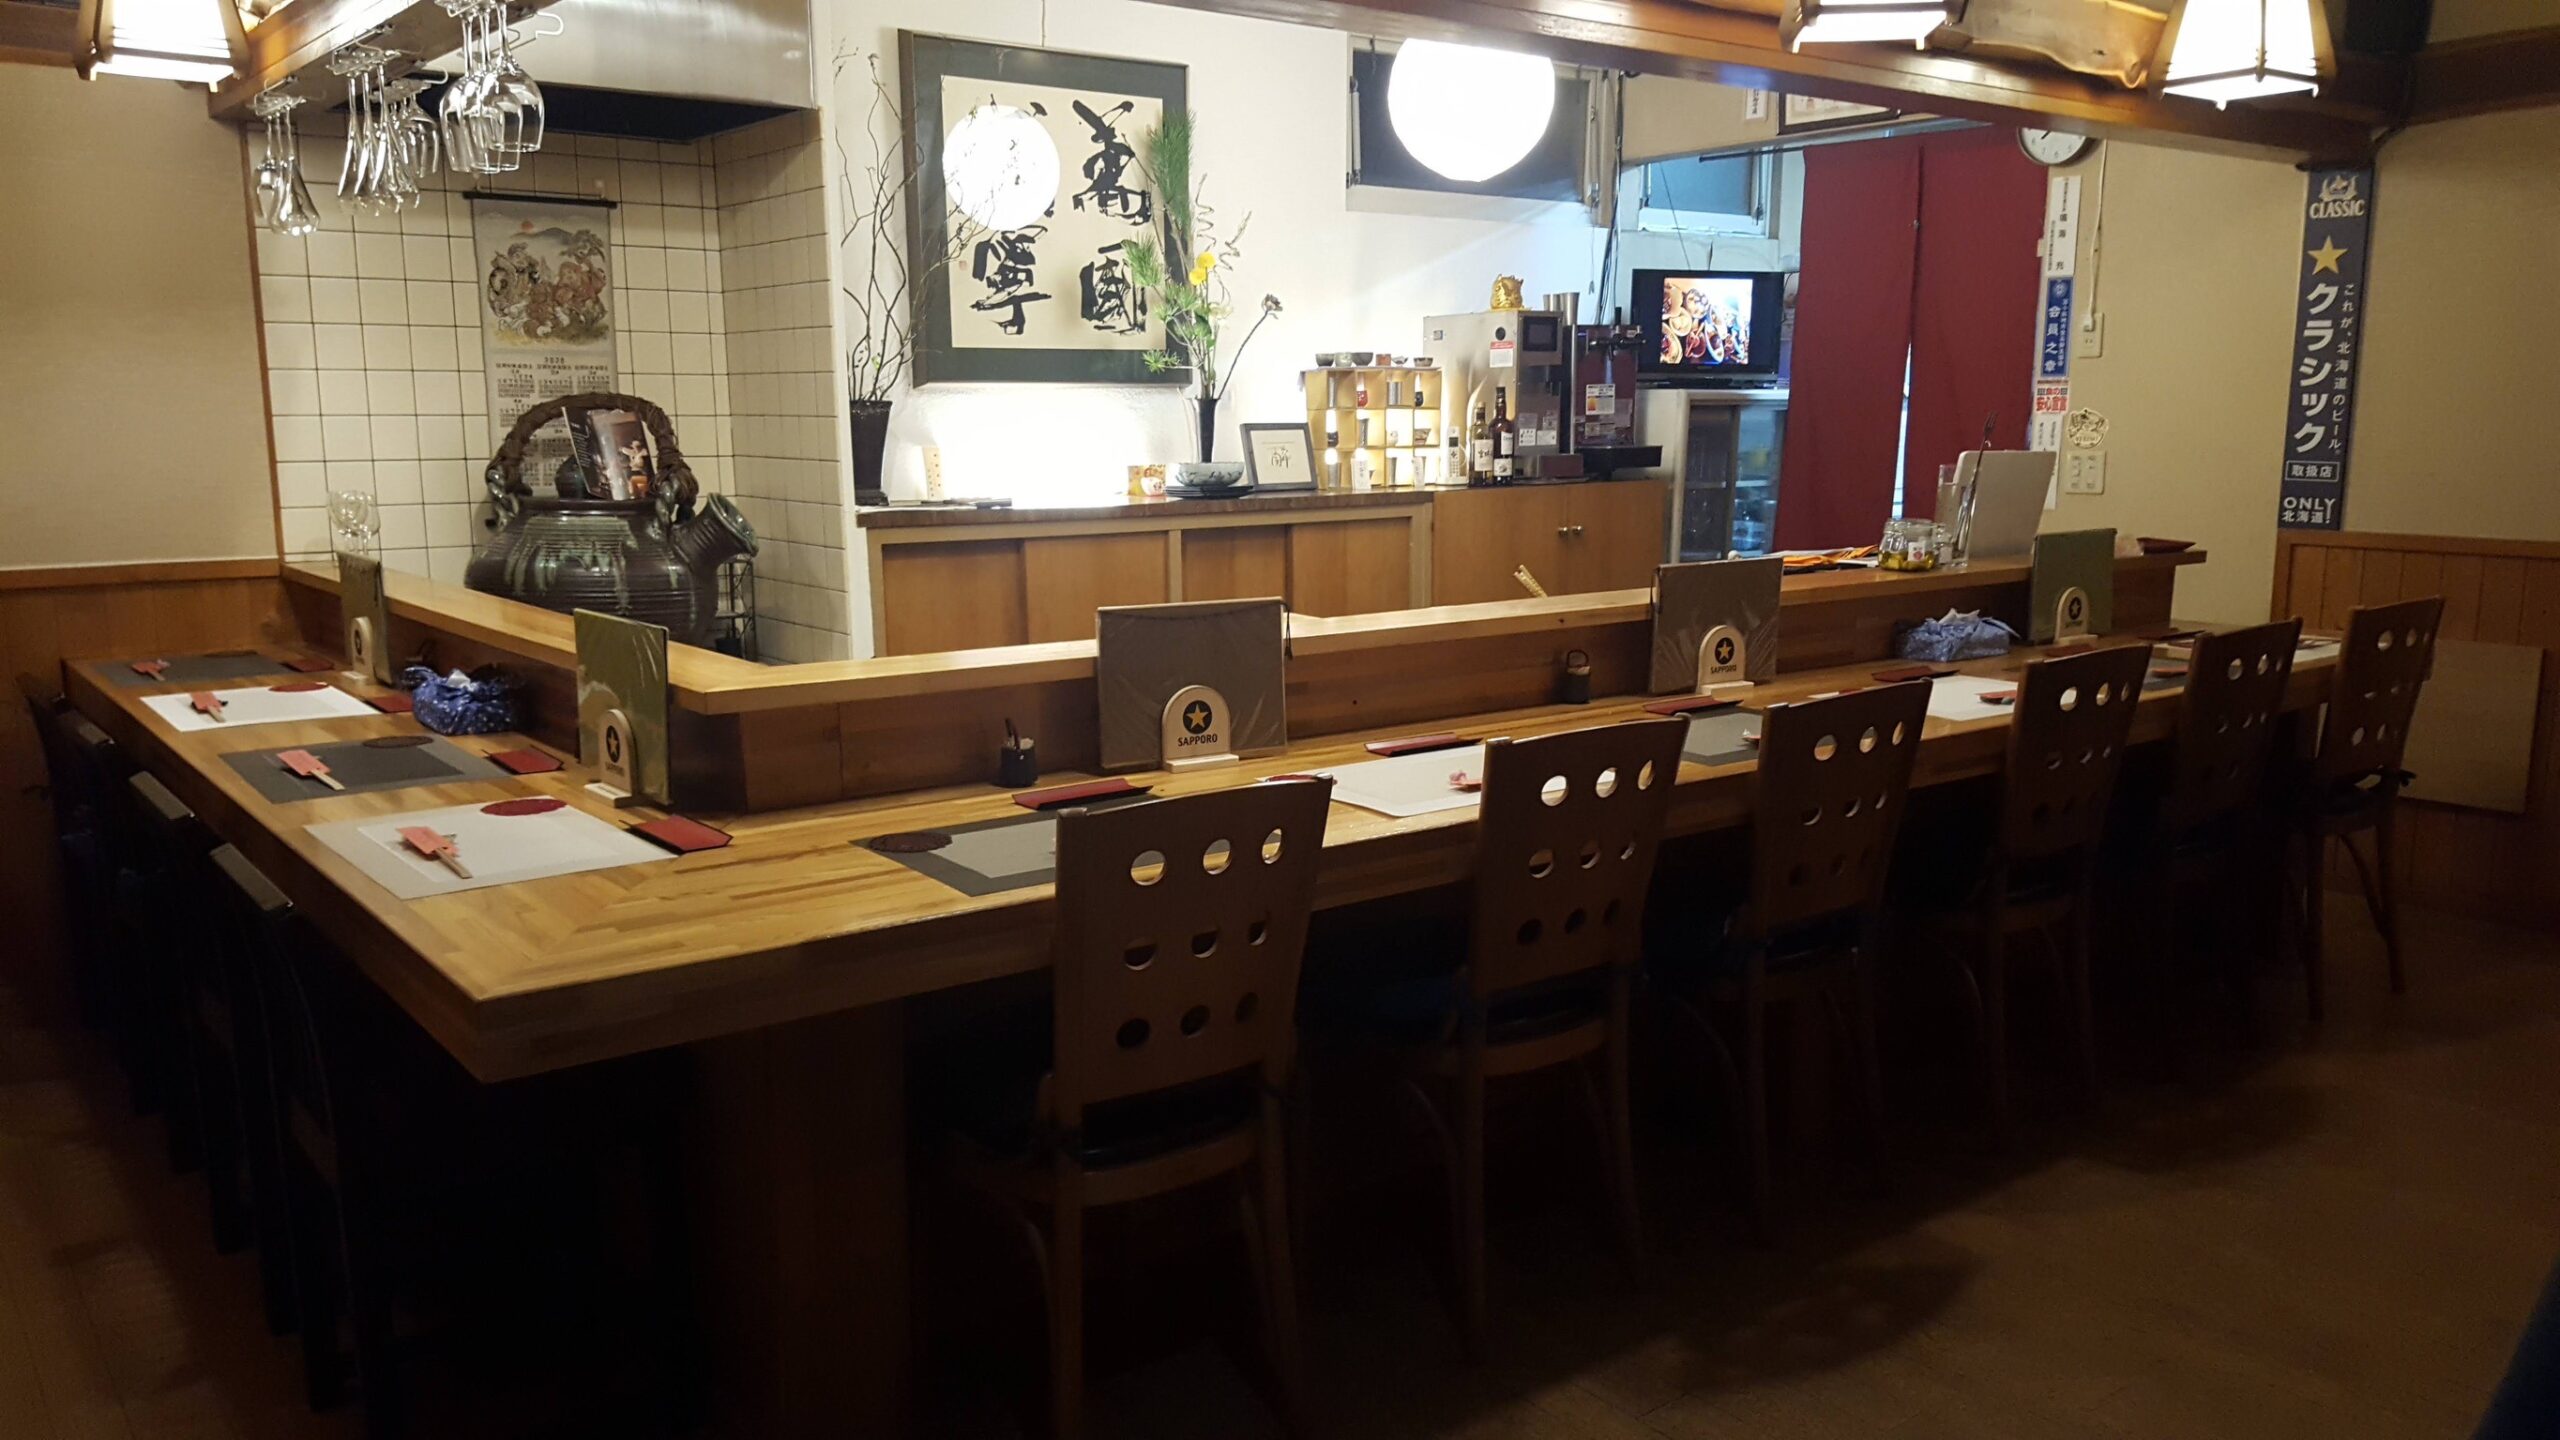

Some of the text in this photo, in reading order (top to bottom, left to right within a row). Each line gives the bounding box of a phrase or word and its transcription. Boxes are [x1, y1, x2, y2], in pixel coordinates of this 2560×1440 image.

[2309, 199, 2365, 219] CLASSIC
[2294, 282, 2339, 453] クラシック
[2291, 464, 2333, 478] 取扱店
[2283, 496, 2336, 515] ONLY
[1710, 664, 1737, 674] SAPPORO
[1177, 733, 1218, 747] SAPPORO
